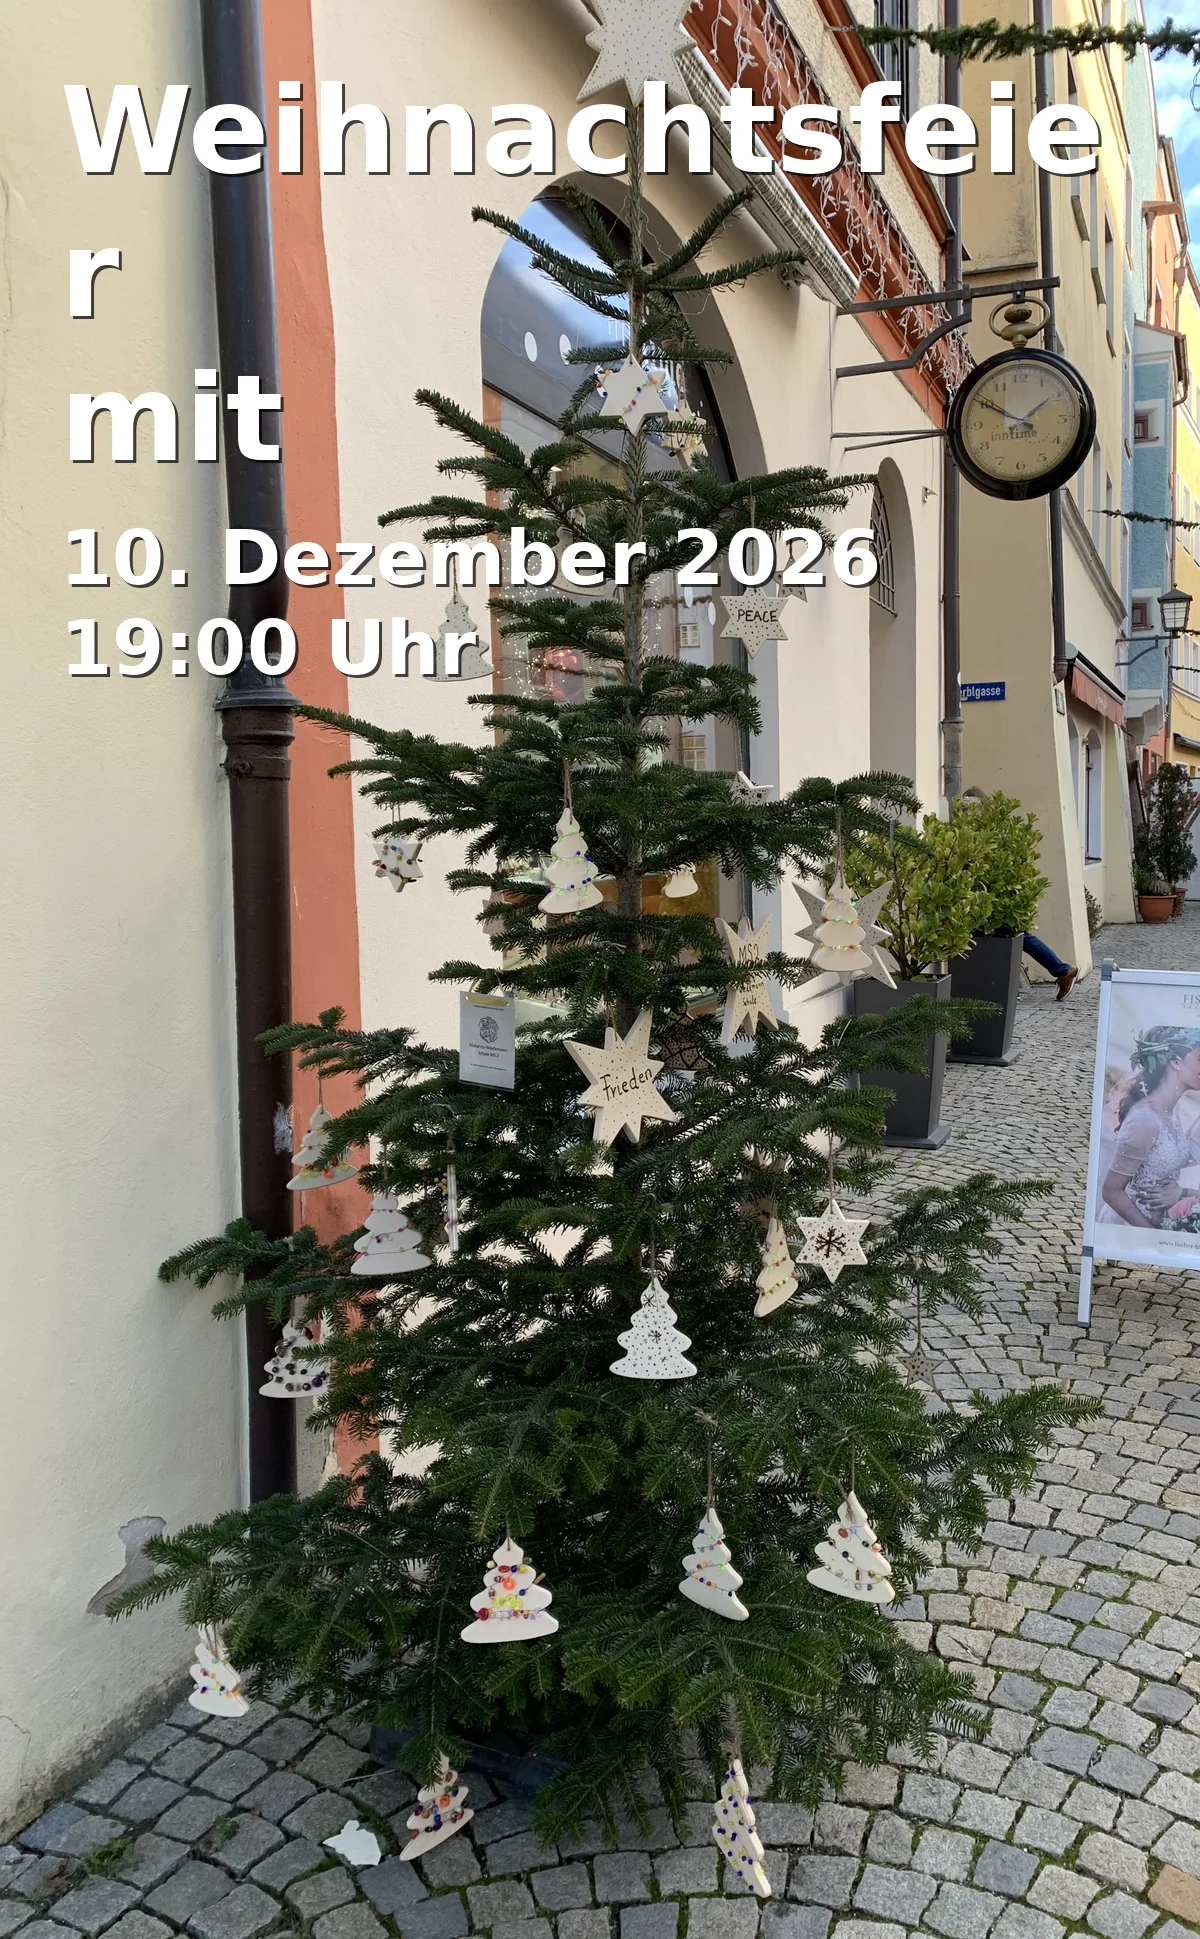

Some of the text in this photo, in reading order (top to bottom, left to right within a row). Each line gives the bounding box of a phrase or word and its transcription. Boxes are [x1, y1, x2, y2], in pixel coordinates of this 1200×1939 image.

[1012, 373, 1028, 383] 12
[995, 383, 1006, 392] 11
[973, 421, 983, 430] 9
[991, 428, 1037, 441] inntime
[980, 441, 990, 450] 8
[1052, 436, 1060, 445] 4
[995, 456, 1004, 466] 7
[1037, 453, 1047, 463] 5
[1015, 461, 1026, 471] 6
[737, 608, 778, 623] PEACE
[600, 1066, 653, 1102] Frieden
